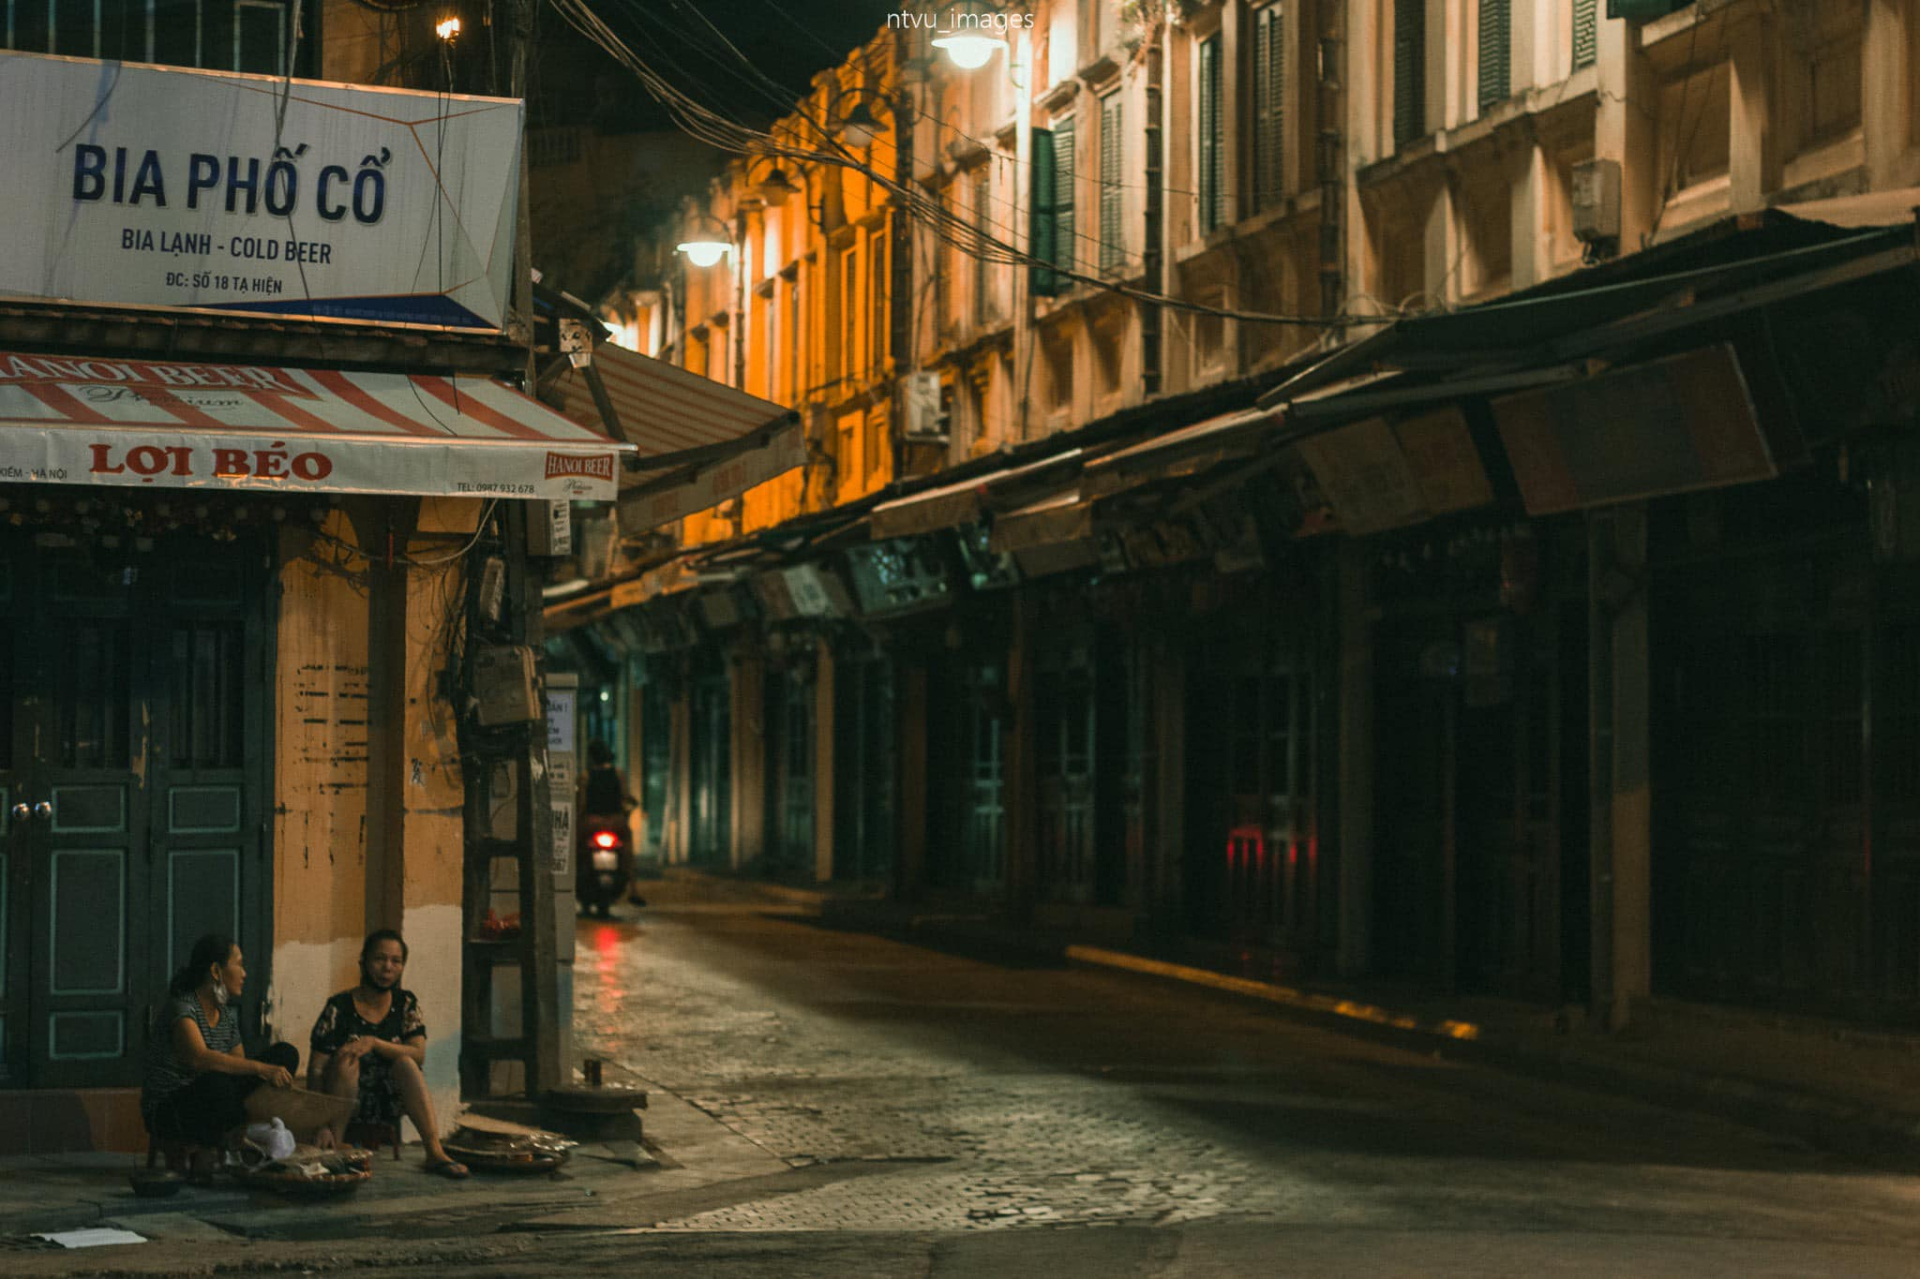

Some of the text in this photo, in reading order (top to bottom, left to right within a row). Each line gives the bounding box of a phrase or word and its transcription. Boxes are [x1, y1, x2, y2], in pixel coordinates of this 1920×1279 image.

[73, 142, 391, 224] BIA PHỐ CỔ
[122, 228, 154, 251] BIA
[161, 231, 211, 257] LẠNH
[231, 236, 279, 260] COLD
[284, 240, 332, 265] BEER
[166, 271, 189, 288] ĐC:
[214, 275, 229, 290] 18
[232, 276, 249, 294] TẠ
[252, 276, 283, 296] HIỆN
[0, 355, 301, 394] ANOI BEER
[212, 440, 333, 481] BÉO
[548, 455, 611, 476] HANOI BEER
[457, 482, 475, 493] TEL:
[500, 484, 517, 494] 932
[518, 484, 535, 495] 678
